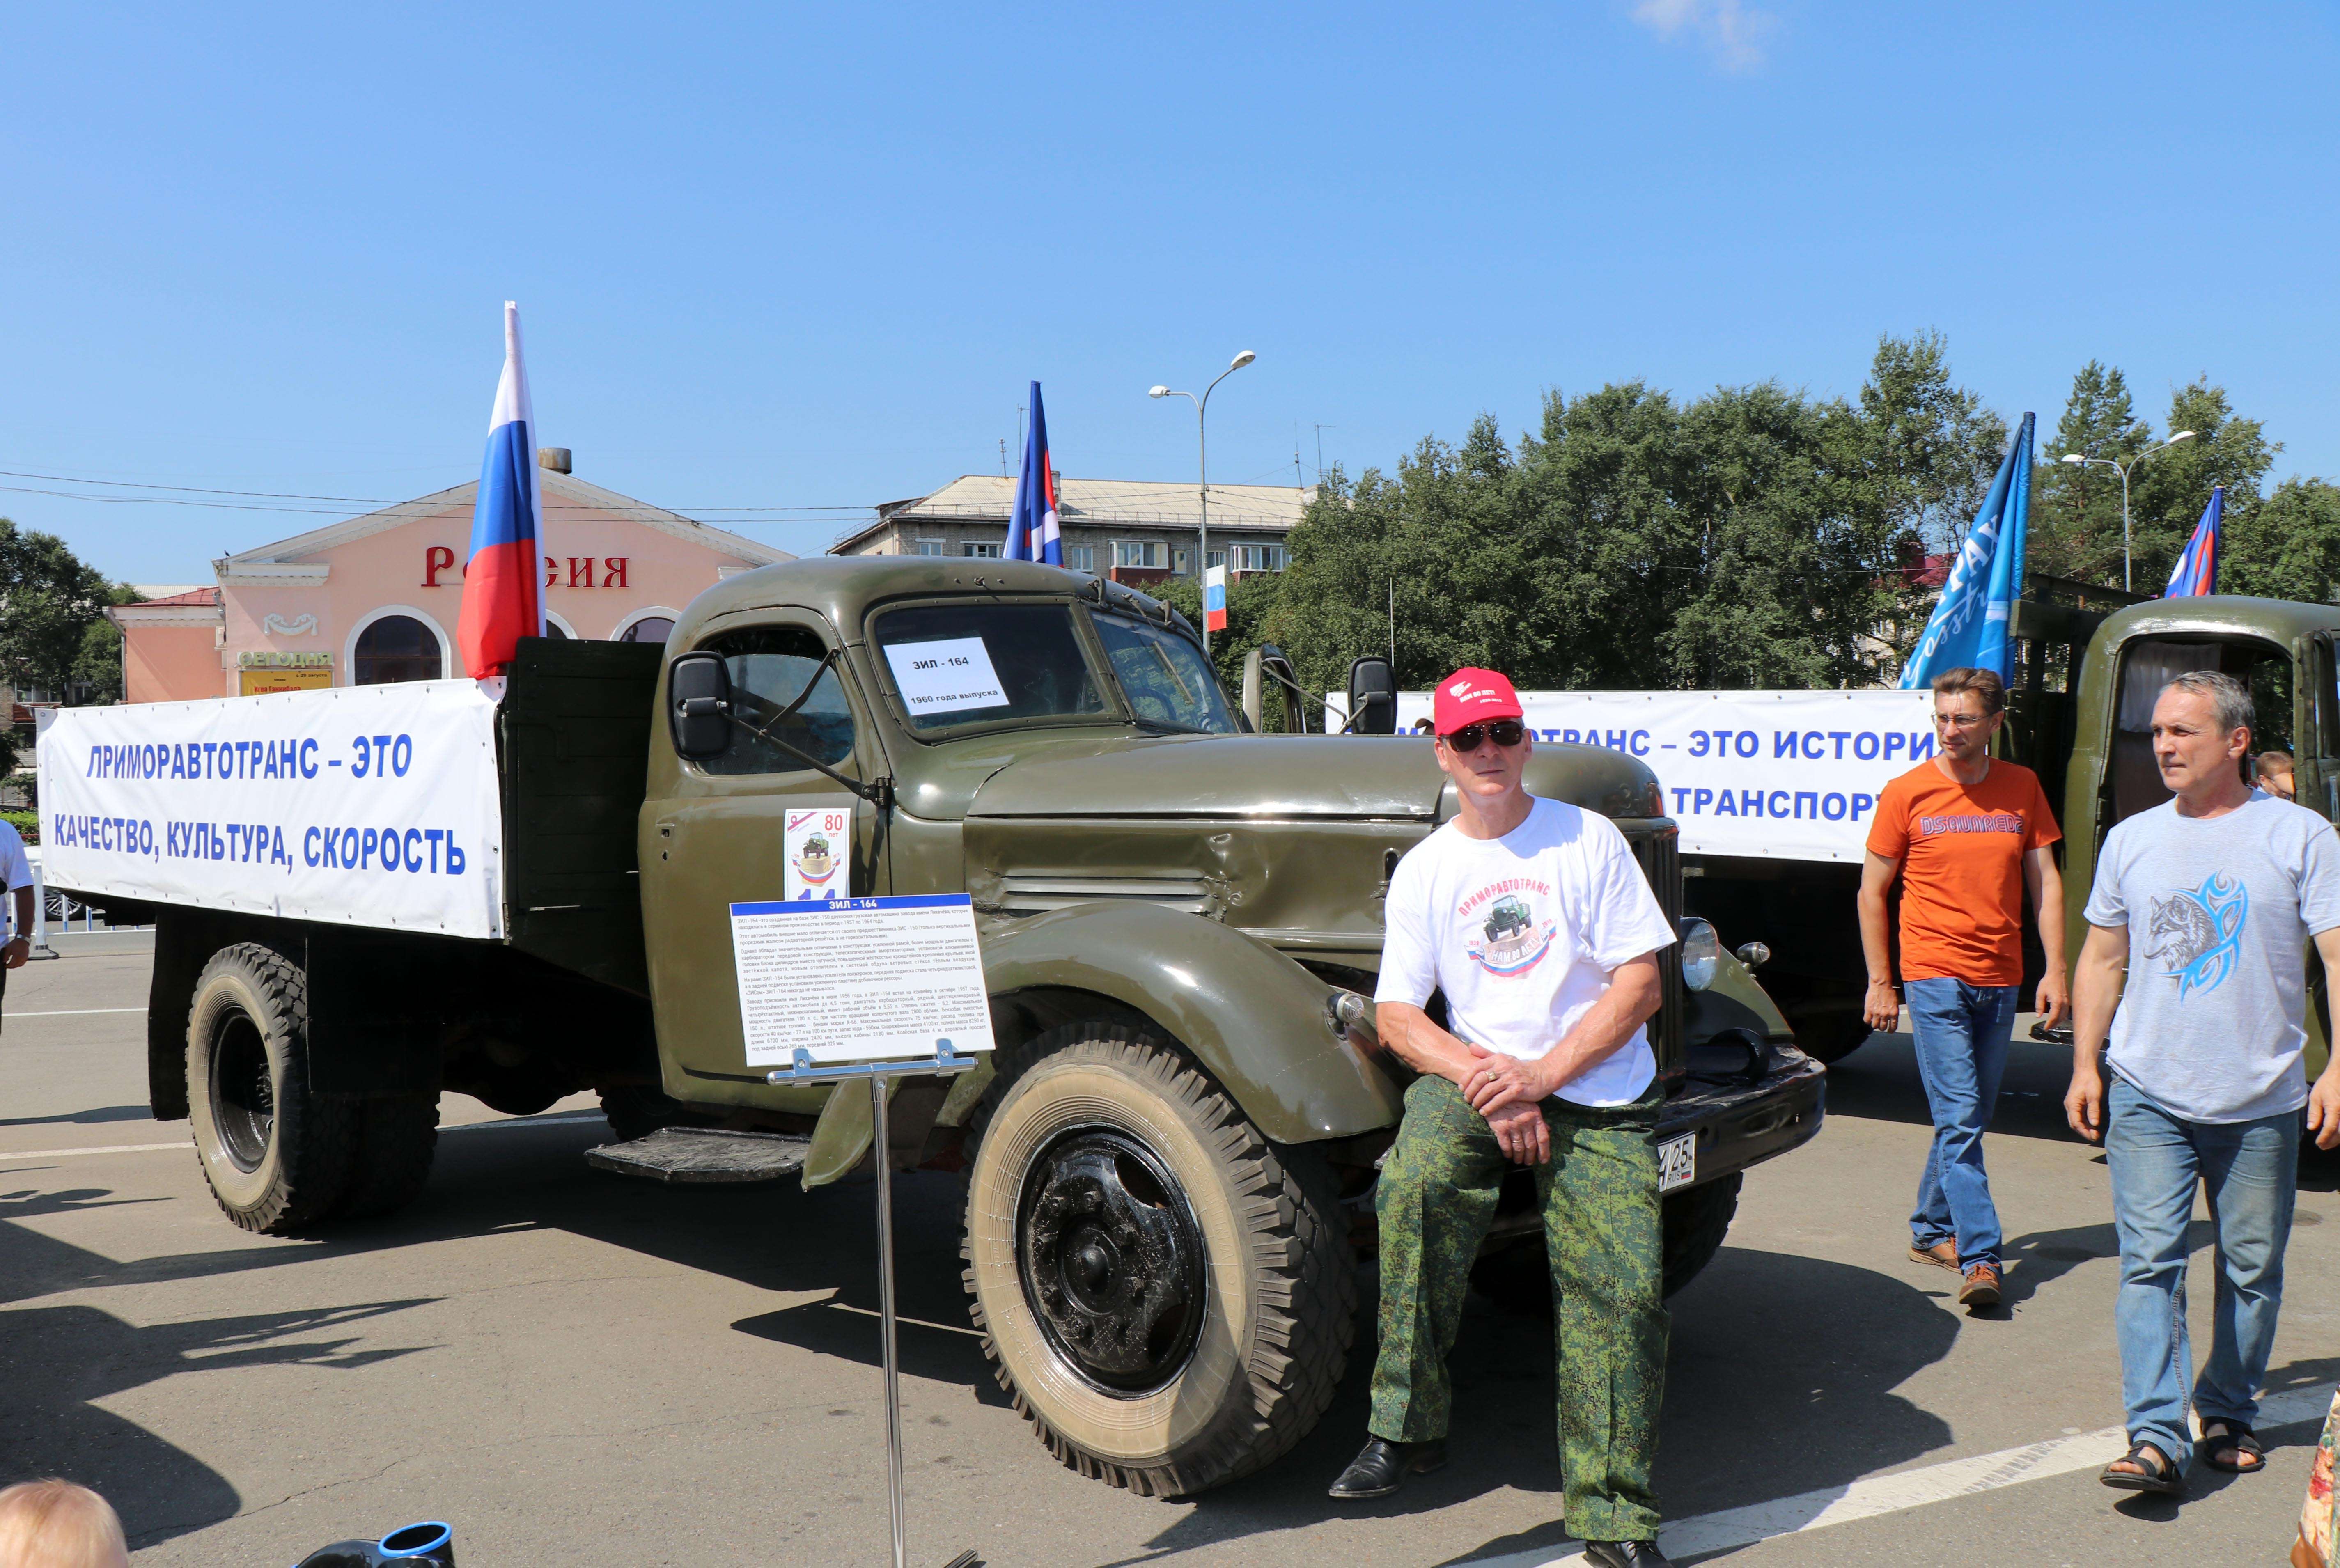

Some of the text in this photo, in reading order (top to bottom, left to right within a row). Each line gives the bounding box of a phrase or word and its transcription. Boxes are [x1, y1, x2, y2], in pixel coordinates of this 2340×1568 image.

[239, 651, 332, 668] СЕГОДНЯ
[913, 660, 938, 670] ЗИЛ
[948, 657, 969, 666] 164
[911, 695, 933, 704] 1960
[959, 690, 998, 699] выпуска
[1688, 731, 1759, 757] ЭТО
[1773, 731, 1944, 761] ИСТОРИ
[351, 734, 412, 779] ЭТО
[1671, 788, 1881, 821] ТРАНСПОР
[825, 814, 843, 831] 80
[1920, 815, 2024, 835] DSQUARED2
[55, 814, 466, 876] КАЧЕСТВО, КУЛЬТУРА, СКОРОСТЬ
[829, 901, 851, 910] ЗИЛ
[860, 900, 877, 909] 164
[1458, 878, 1550, 916] ПРИМОРАВТОТРАНС
[1491, 949, 1512, 962] НАМ
[1512, 950, 1521, 960] 80
[1671, 1139, 1688, 1171] 25
[1668, 1171, 1680, 1183] RUS
